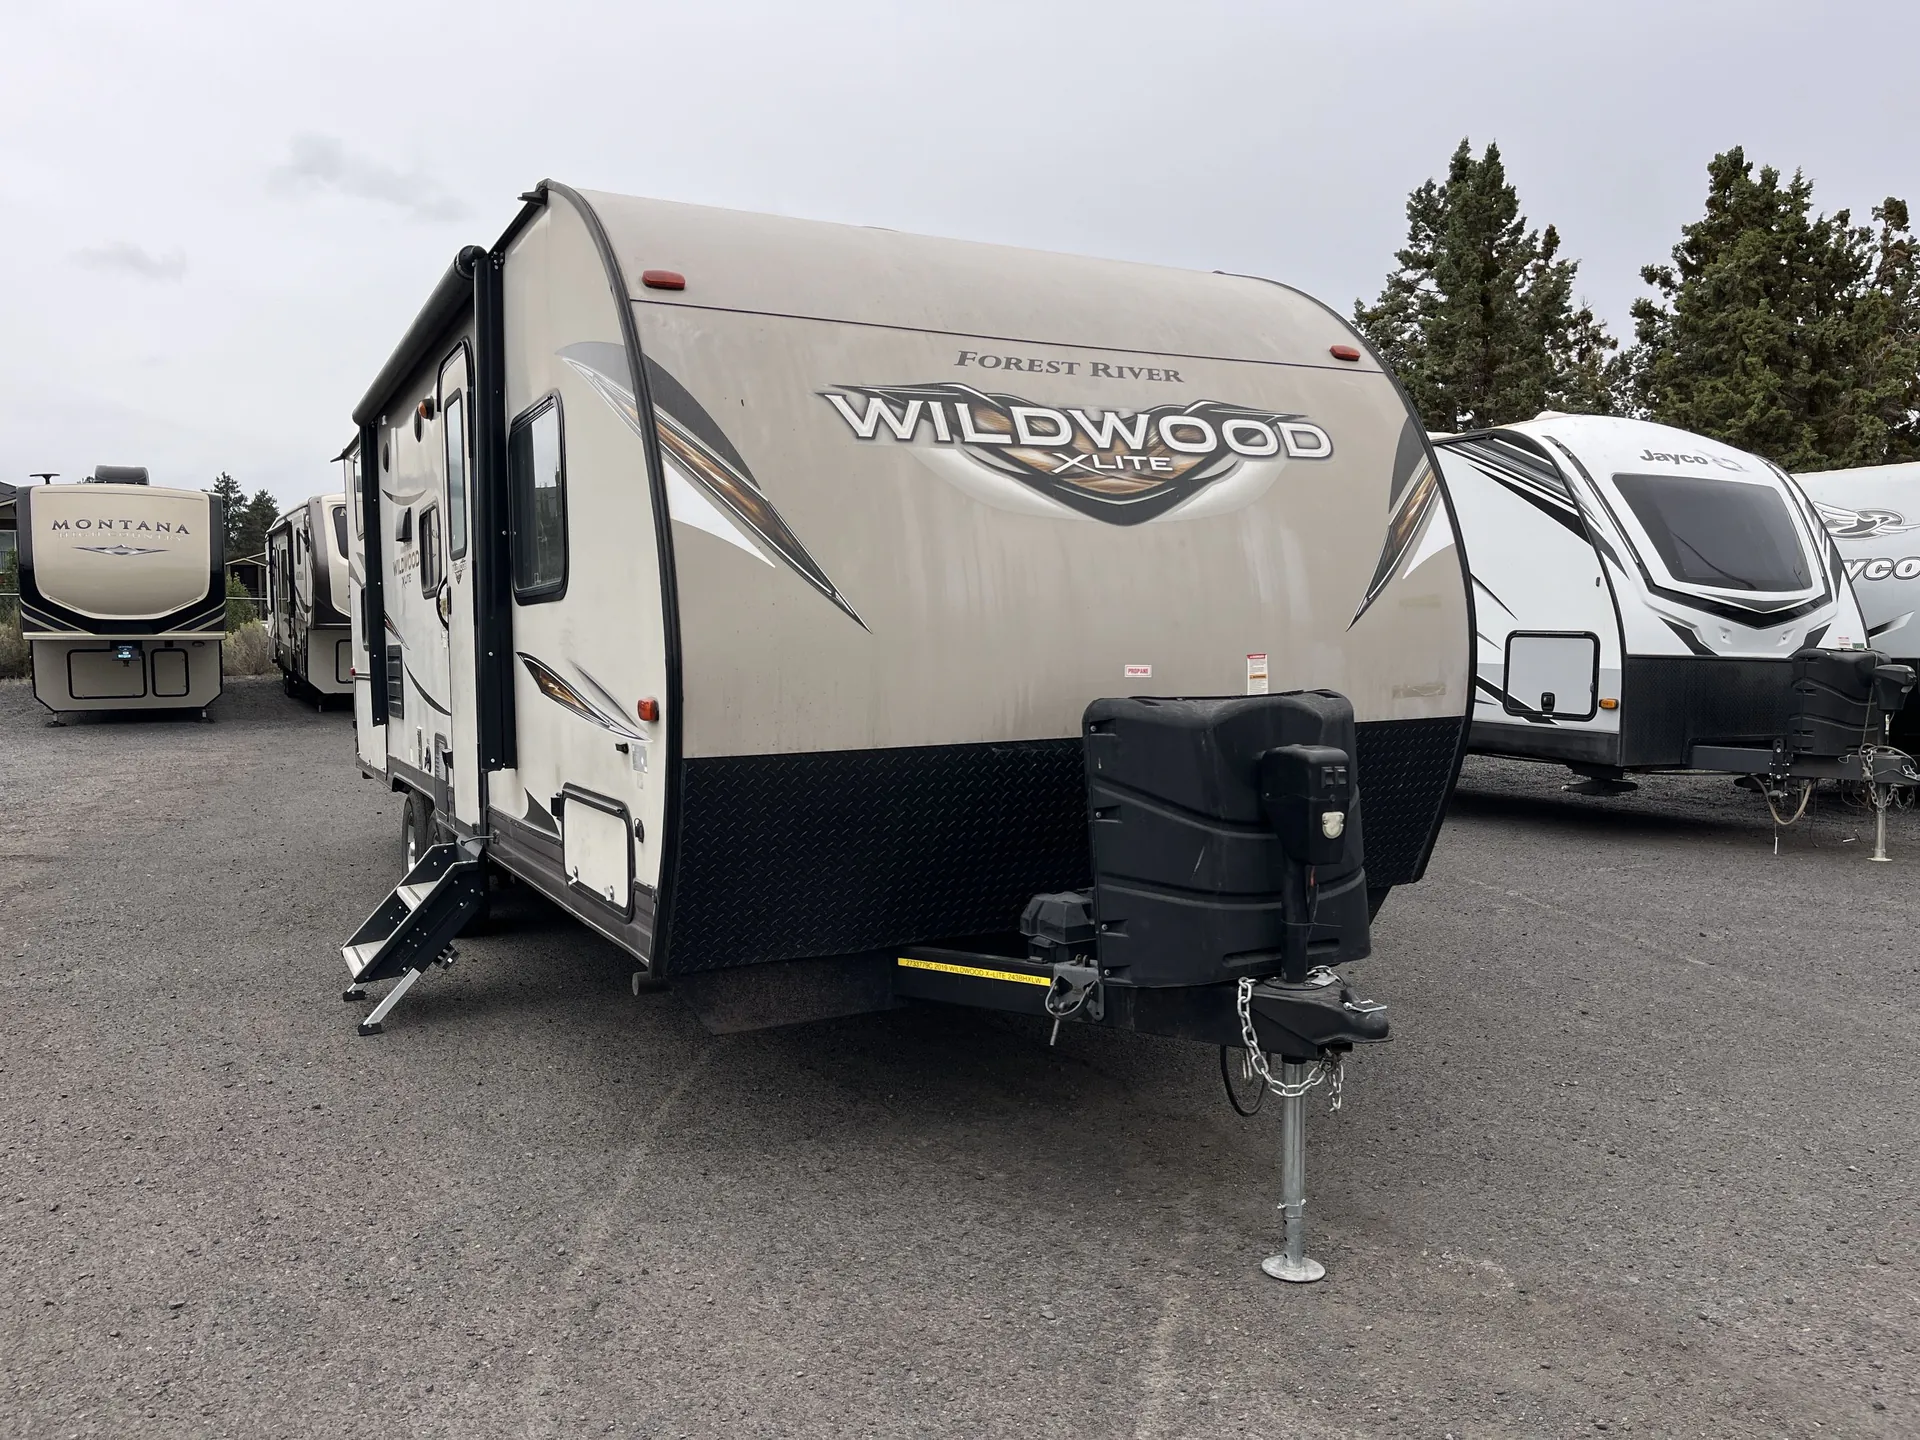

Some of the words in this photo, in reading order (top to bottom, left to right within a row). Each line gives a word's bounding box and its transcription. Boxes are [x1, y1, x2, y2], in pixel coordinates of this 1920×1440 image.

[954, 350, 1080, 375] FOREST
[1089, 361, 1184, 383] RIVER
[820, 392, 1334, 458] WILDWOOD
[1640, 449, 1708, 465] Jayco
[51, 519, 190, 535] MONTANA
[1841, 556, 1920, 582] YCO
[949, 966, 984, 975] WILDWOOD
